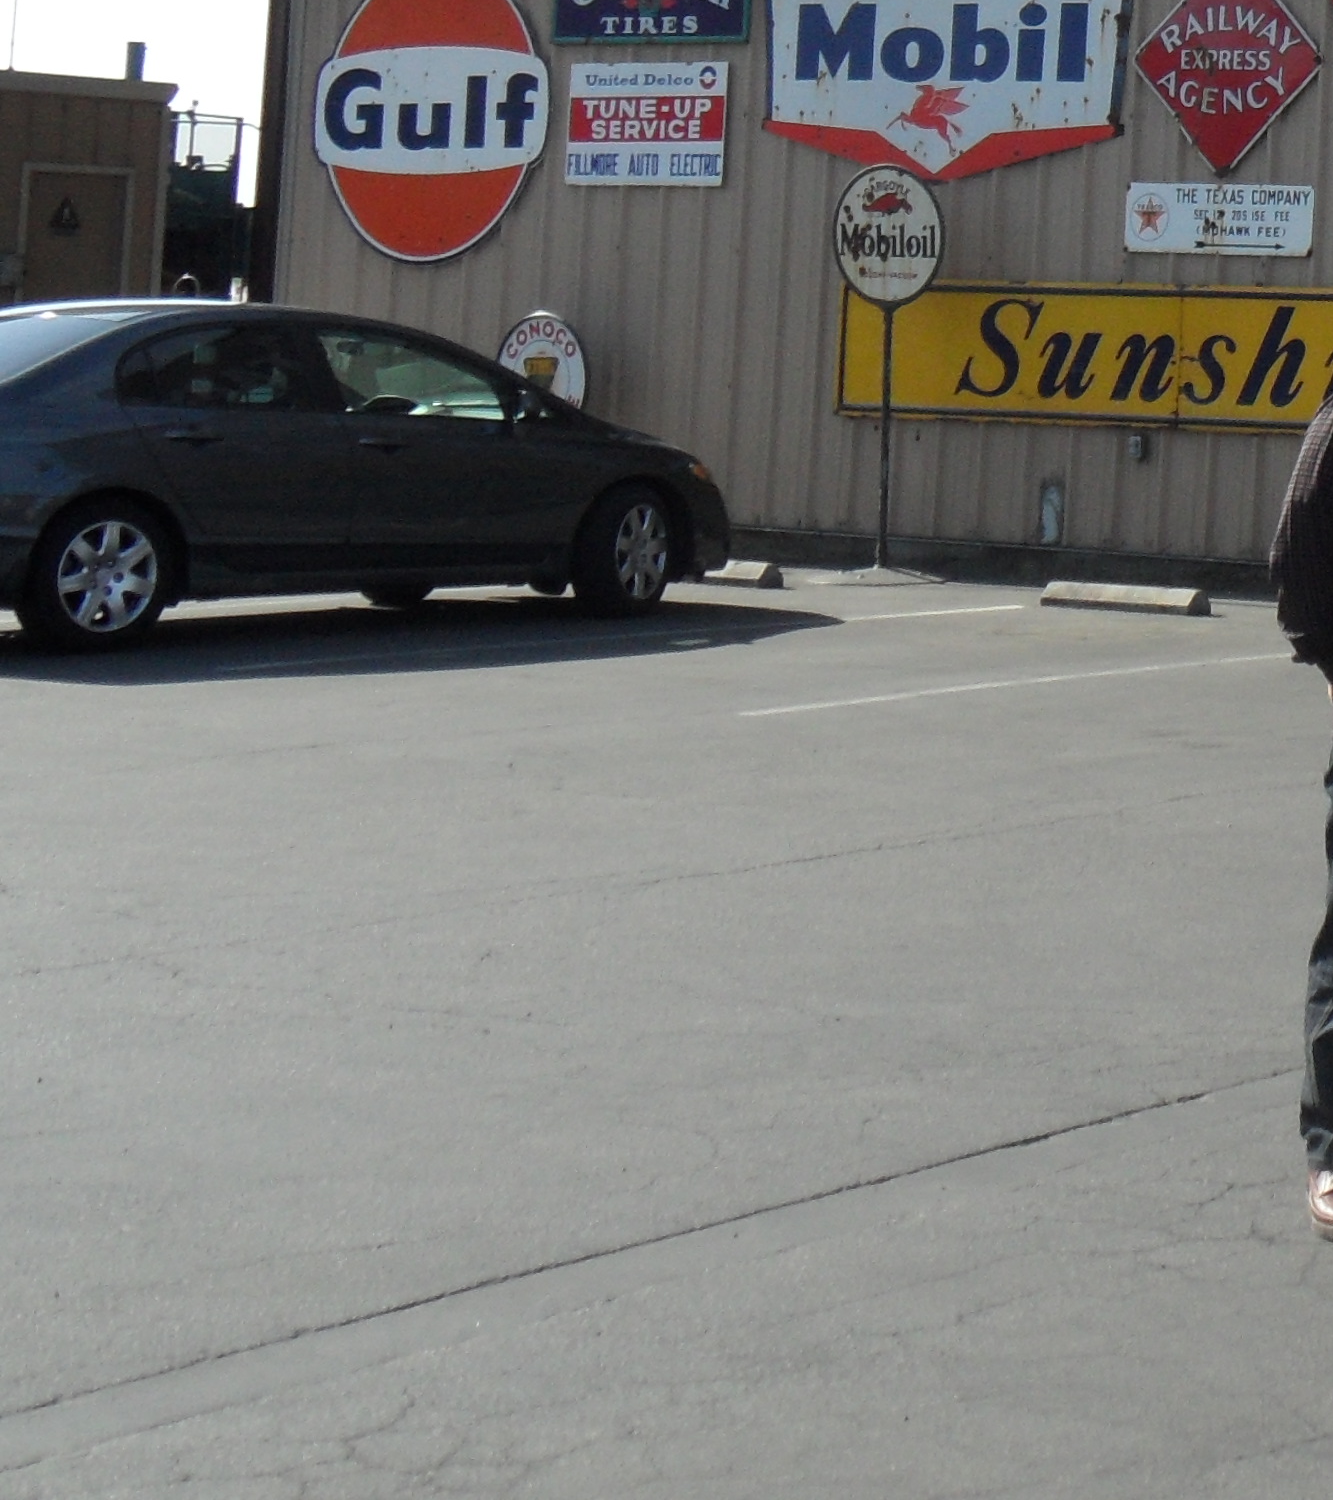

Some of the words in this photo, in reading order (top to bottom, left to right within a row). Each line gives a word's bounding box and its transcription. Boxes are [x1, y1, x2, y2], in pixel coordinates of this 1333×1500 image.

[600, 15, 699, 35] TIRES
[1159, 4, 1302, 55] RAILWAY
[794, 0, 1090, 84] Mobil
[1180, 49, 1272, 72] EXPRESS
[585, 73, 640, 88] United
[642, 73, 694, 87] Delco
[1156, 66, 1287, 115] AGENCY
[322, 68, 540, 151] Gulf
[582, 98, 713, 120] TUNE-UP
[590, 119, 702, 141] SERVICE
[566, 152, 620, 177] FILLMORE
[627, 152, 660, 177] AUTO
[669, 152, 722, 177] ELECTRIC
[1175, 188, 1198, 205] THE
[1205, 188, 1245, 206] TEXAS
[1251, 189, 1312, 207] COMPANY
[1274, 210, 1291, 222] FEE
[840, 223, 938, 260] Mobiloil
[506, 320, 577, 360] CONOCO
